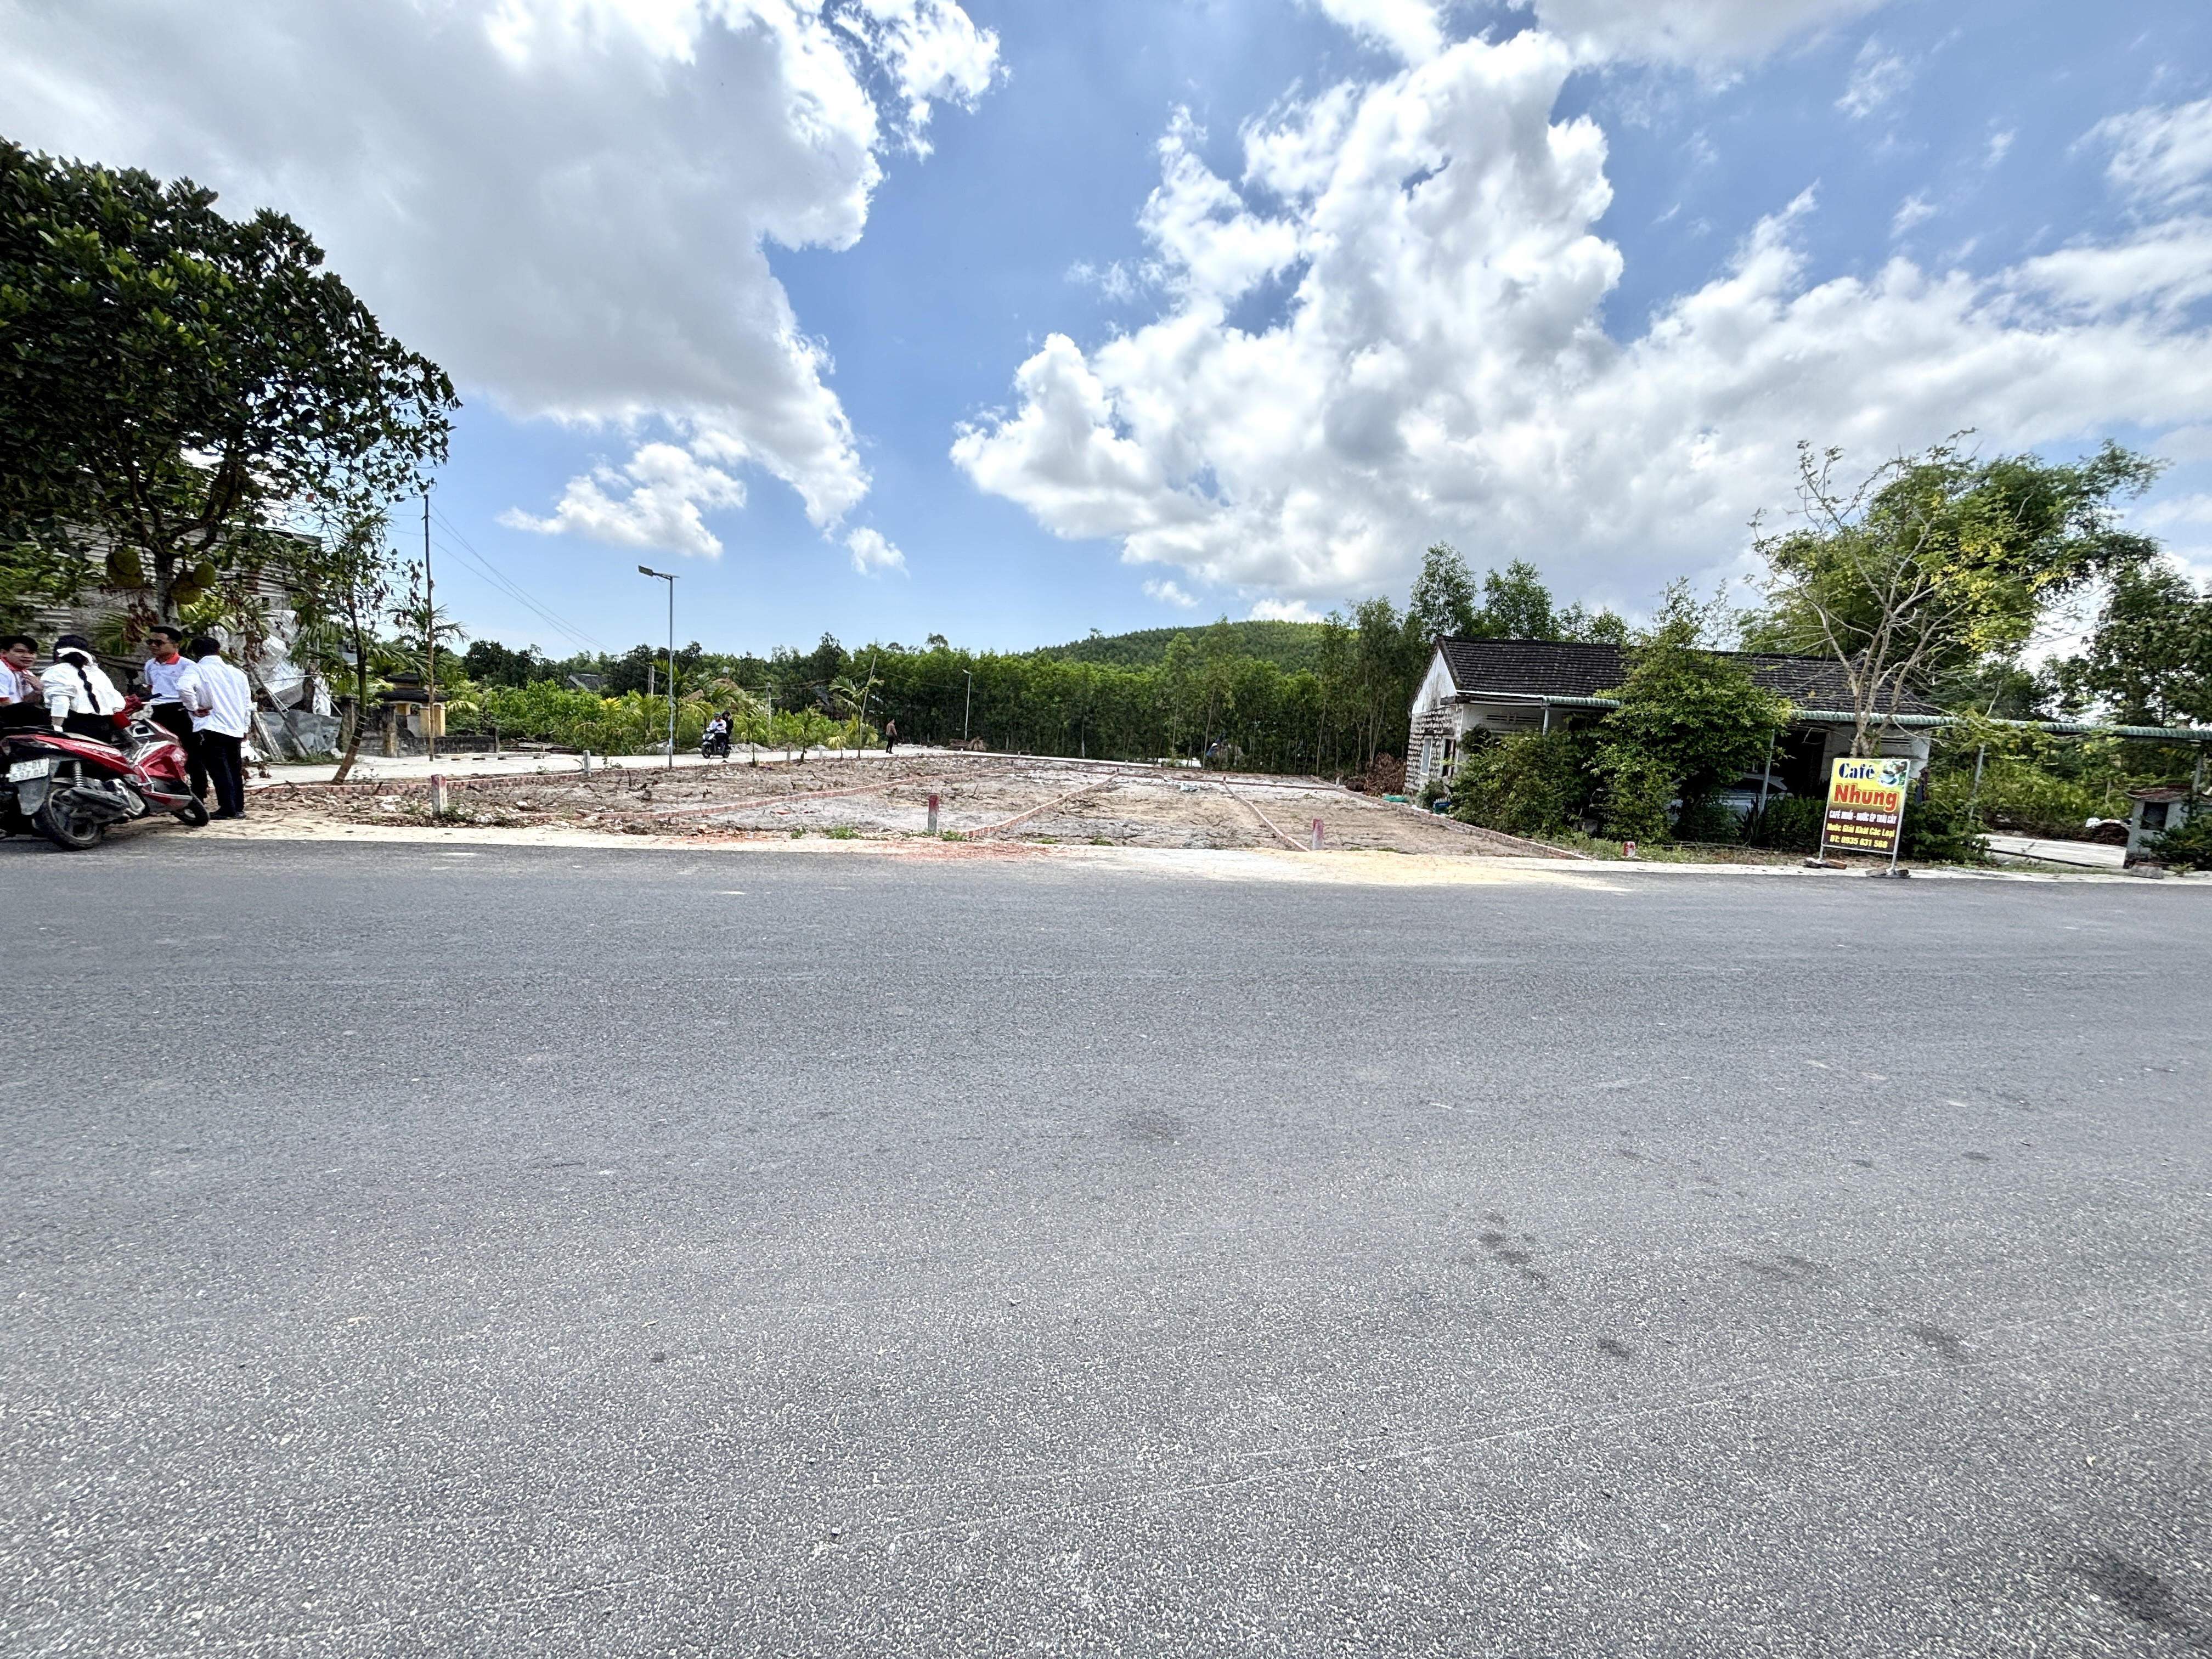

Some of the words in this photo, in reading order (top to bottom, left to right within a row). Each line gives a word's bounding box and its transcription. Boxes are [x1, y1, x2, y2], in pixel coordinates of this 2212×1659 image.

[1839, 763, 1875, 780] Café
[1833, 783, 1899, 812] Nhung
[1856, 812, 1870, 822] NƯỚC
[1869, 812, 1876, 822] ÉP
[1877, 813, 1887, 823] TRÁI
[1887, 814, 1897, 825] CÂY
[1827, 823, 1842, 832] Nước
[1842, 825, 1855, 833] Giải
[1855, 826, 1869, 834] Khát
[1870, 827, 1881, 836] Các
[1882, 828, 1895, 839] Loại
